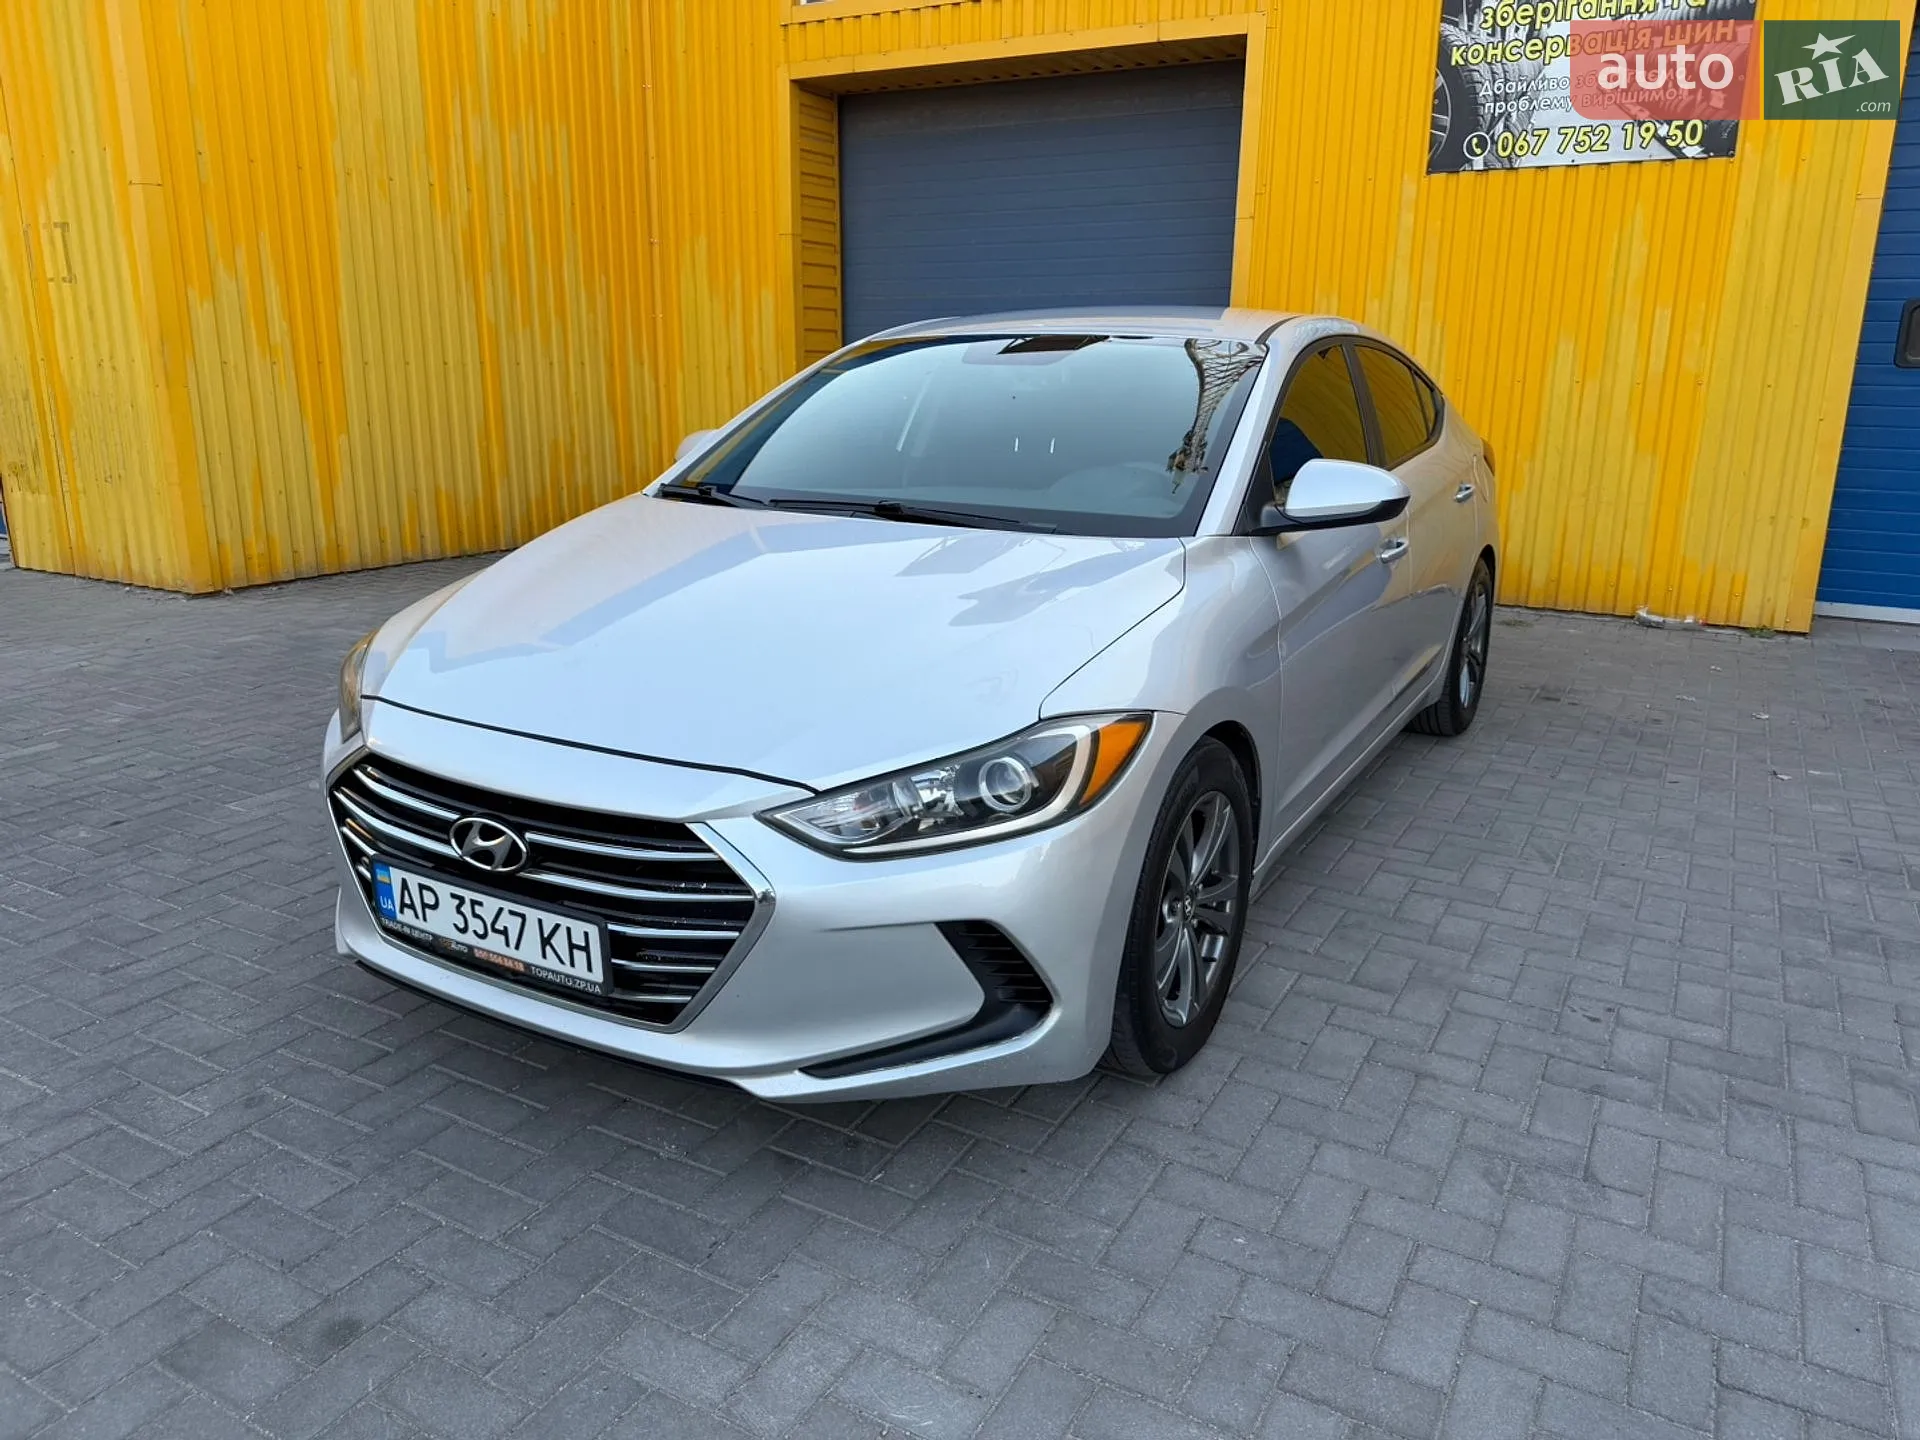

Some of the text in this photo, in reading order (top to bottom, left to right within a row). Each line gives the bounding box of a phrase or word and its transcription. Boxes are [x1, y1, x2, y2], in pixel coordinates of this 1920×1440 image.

[1450, 18, 1736, 67] консервація шин
[1479, 74, 1570, 98] Дбайливо
[1484, 95, 1577, 117] проблему
[1496, 128, 1549, 158] 067
[1557, 124, 1610, 155] 752
[1622, 120, 1657, 150] 19
[1665, 119, 1704, 147] 50
[380, 894, 395, 911] UA
[399, 877, 440, 922] AP
[449, 892, 527, 951] 3547
[537, 917, 593, 973] KH
